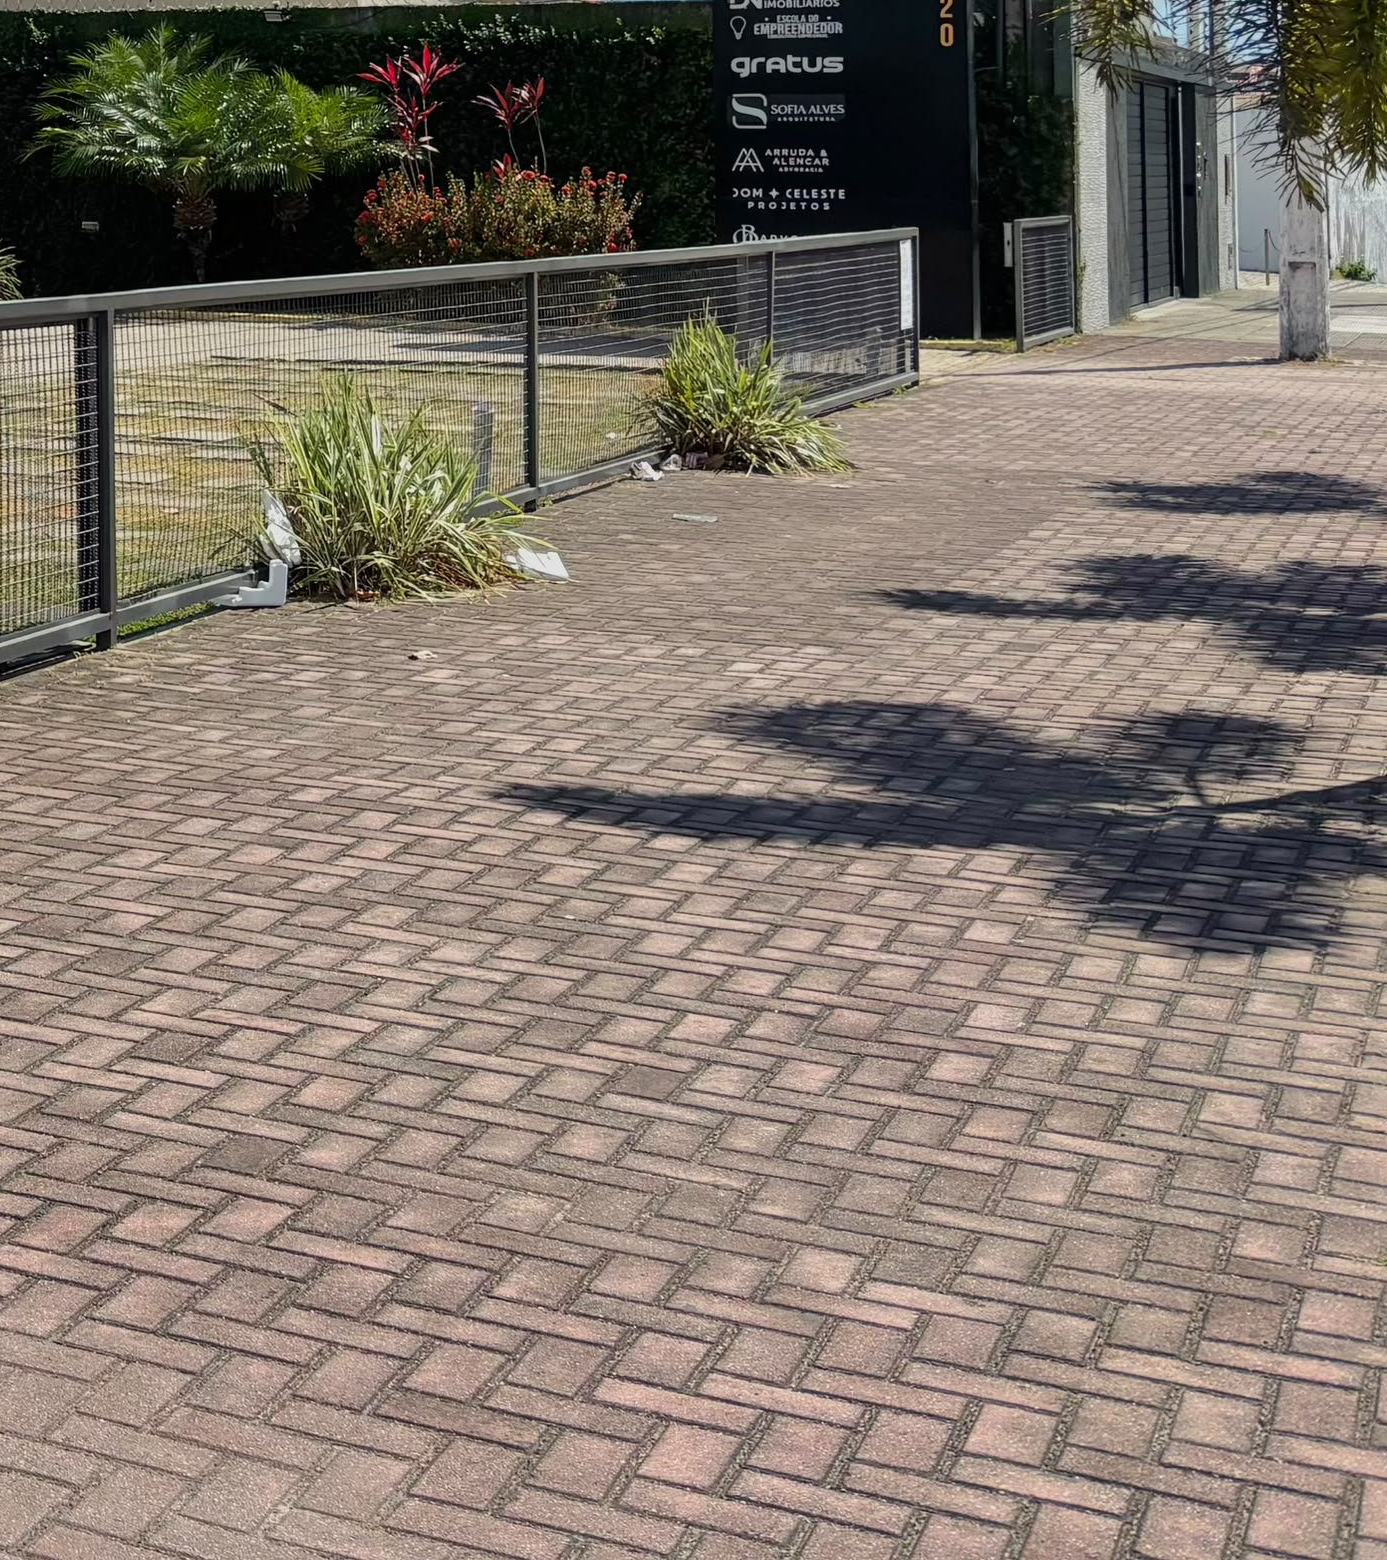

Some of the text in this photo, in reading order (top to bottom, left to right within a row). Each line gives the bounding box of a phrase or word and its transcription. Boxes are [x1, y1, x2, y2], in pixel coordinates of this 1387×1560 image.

[776, 13, 820, 23] ESCOLA DO
[753, 21, 844, 36] EMPREENDEDOR
[730, 54, 845, 78] gratus
[769, 104, 807, 115] SOFIA
[807, 104, 846, 115] ALVES
[764, 148, 816, 157] ARRUDA
[772, 157, 831, 166] ALENCAR
[785, 188, 847, 200] CELESTE
[747, 201, 831, 211] PROJETOS
